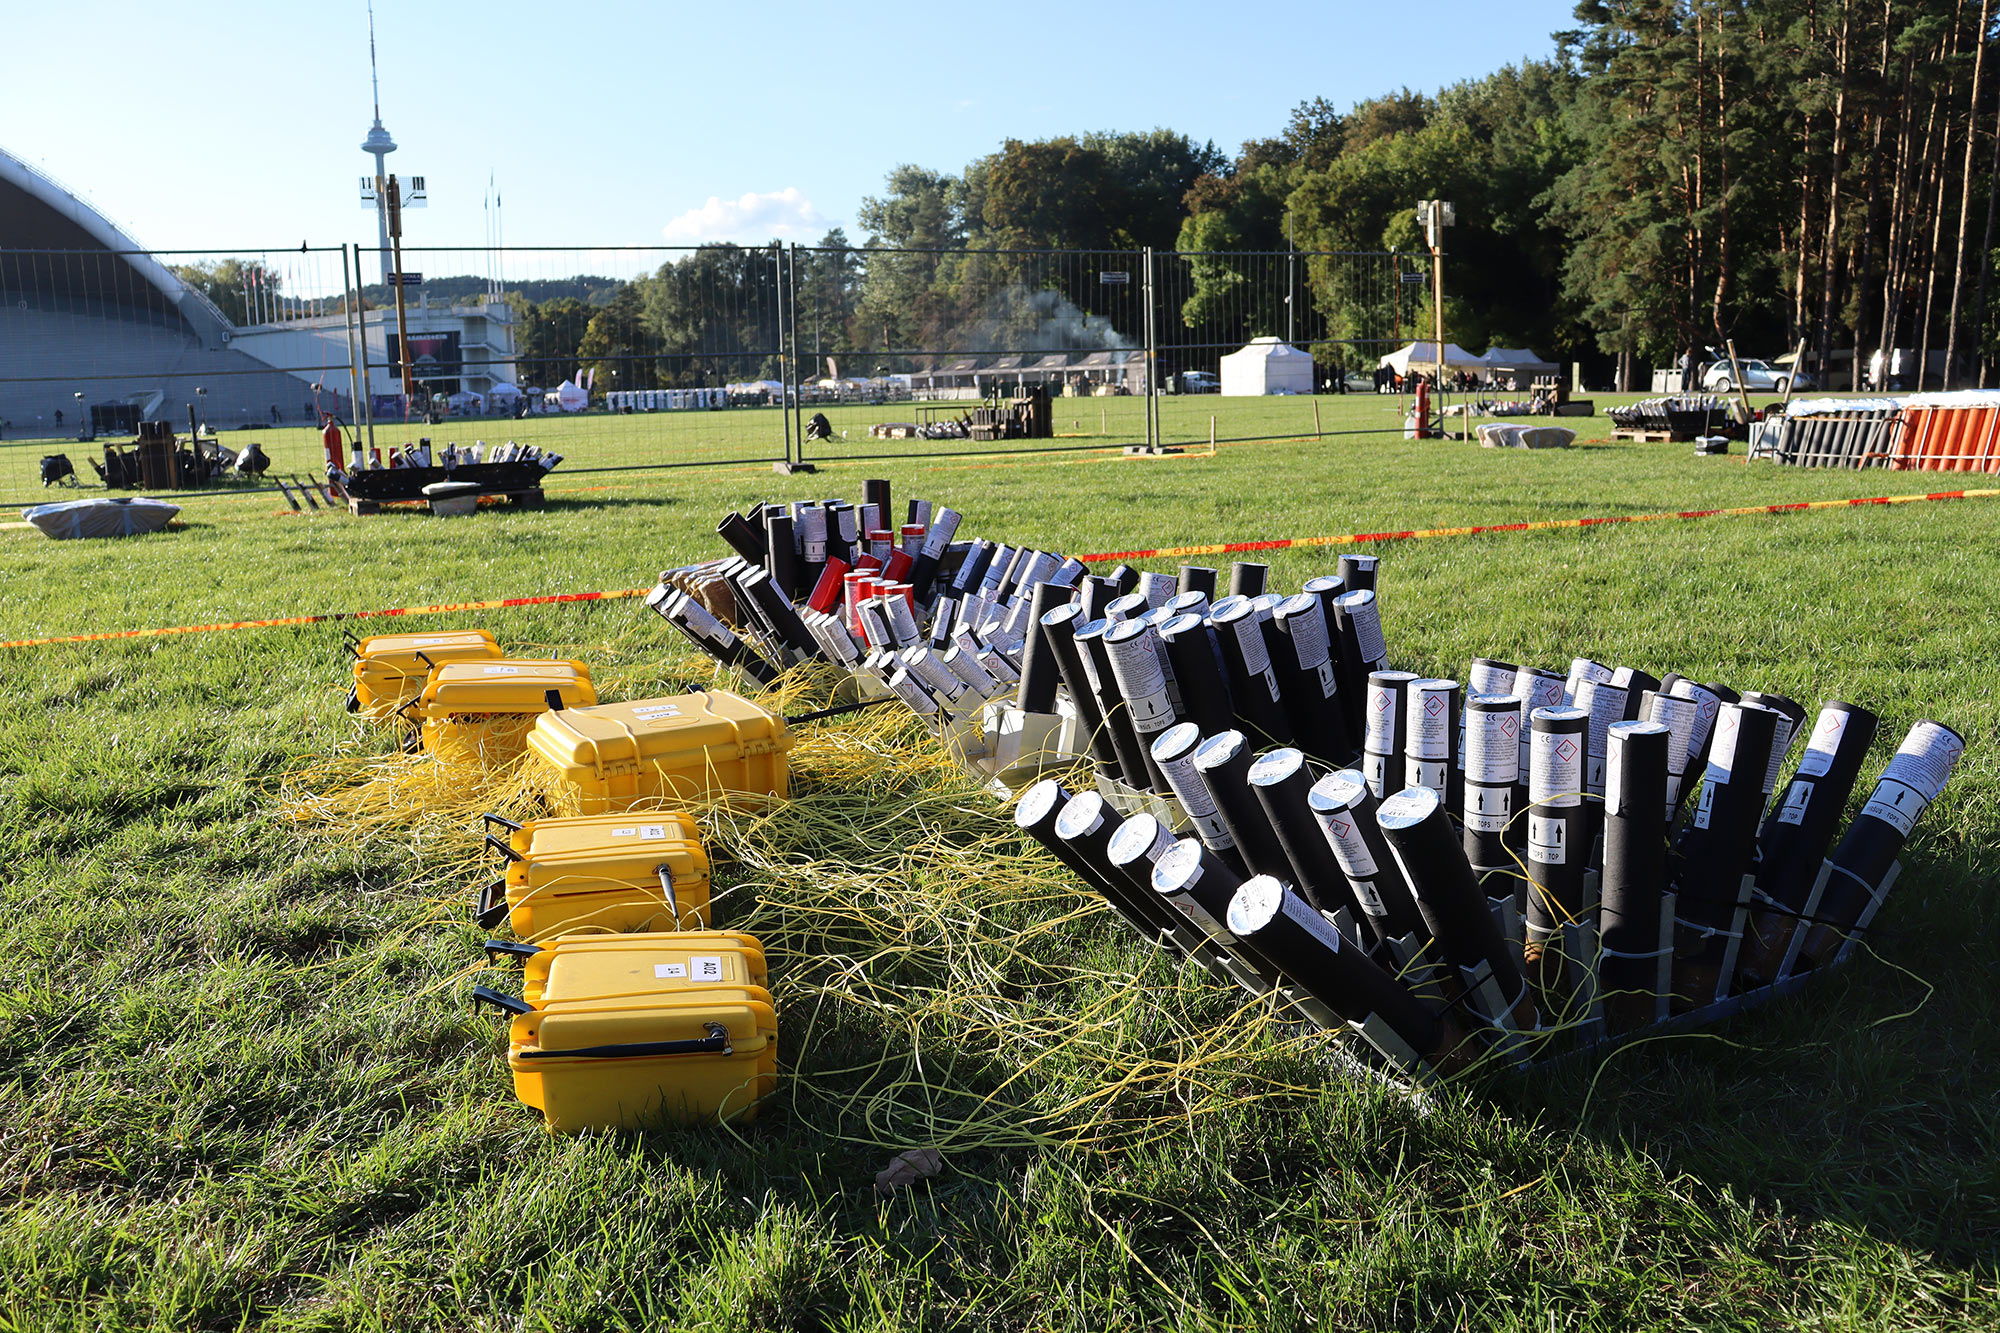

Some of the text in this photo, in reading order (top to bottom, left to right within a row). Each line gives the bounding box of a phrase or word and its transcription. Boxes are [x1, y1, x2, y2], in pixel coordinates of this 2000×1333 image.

[1478, 820, 1491, 828] TOPS
[1548, 852, 1560, 860] TOP
[703, 961, 717, 975] A02
